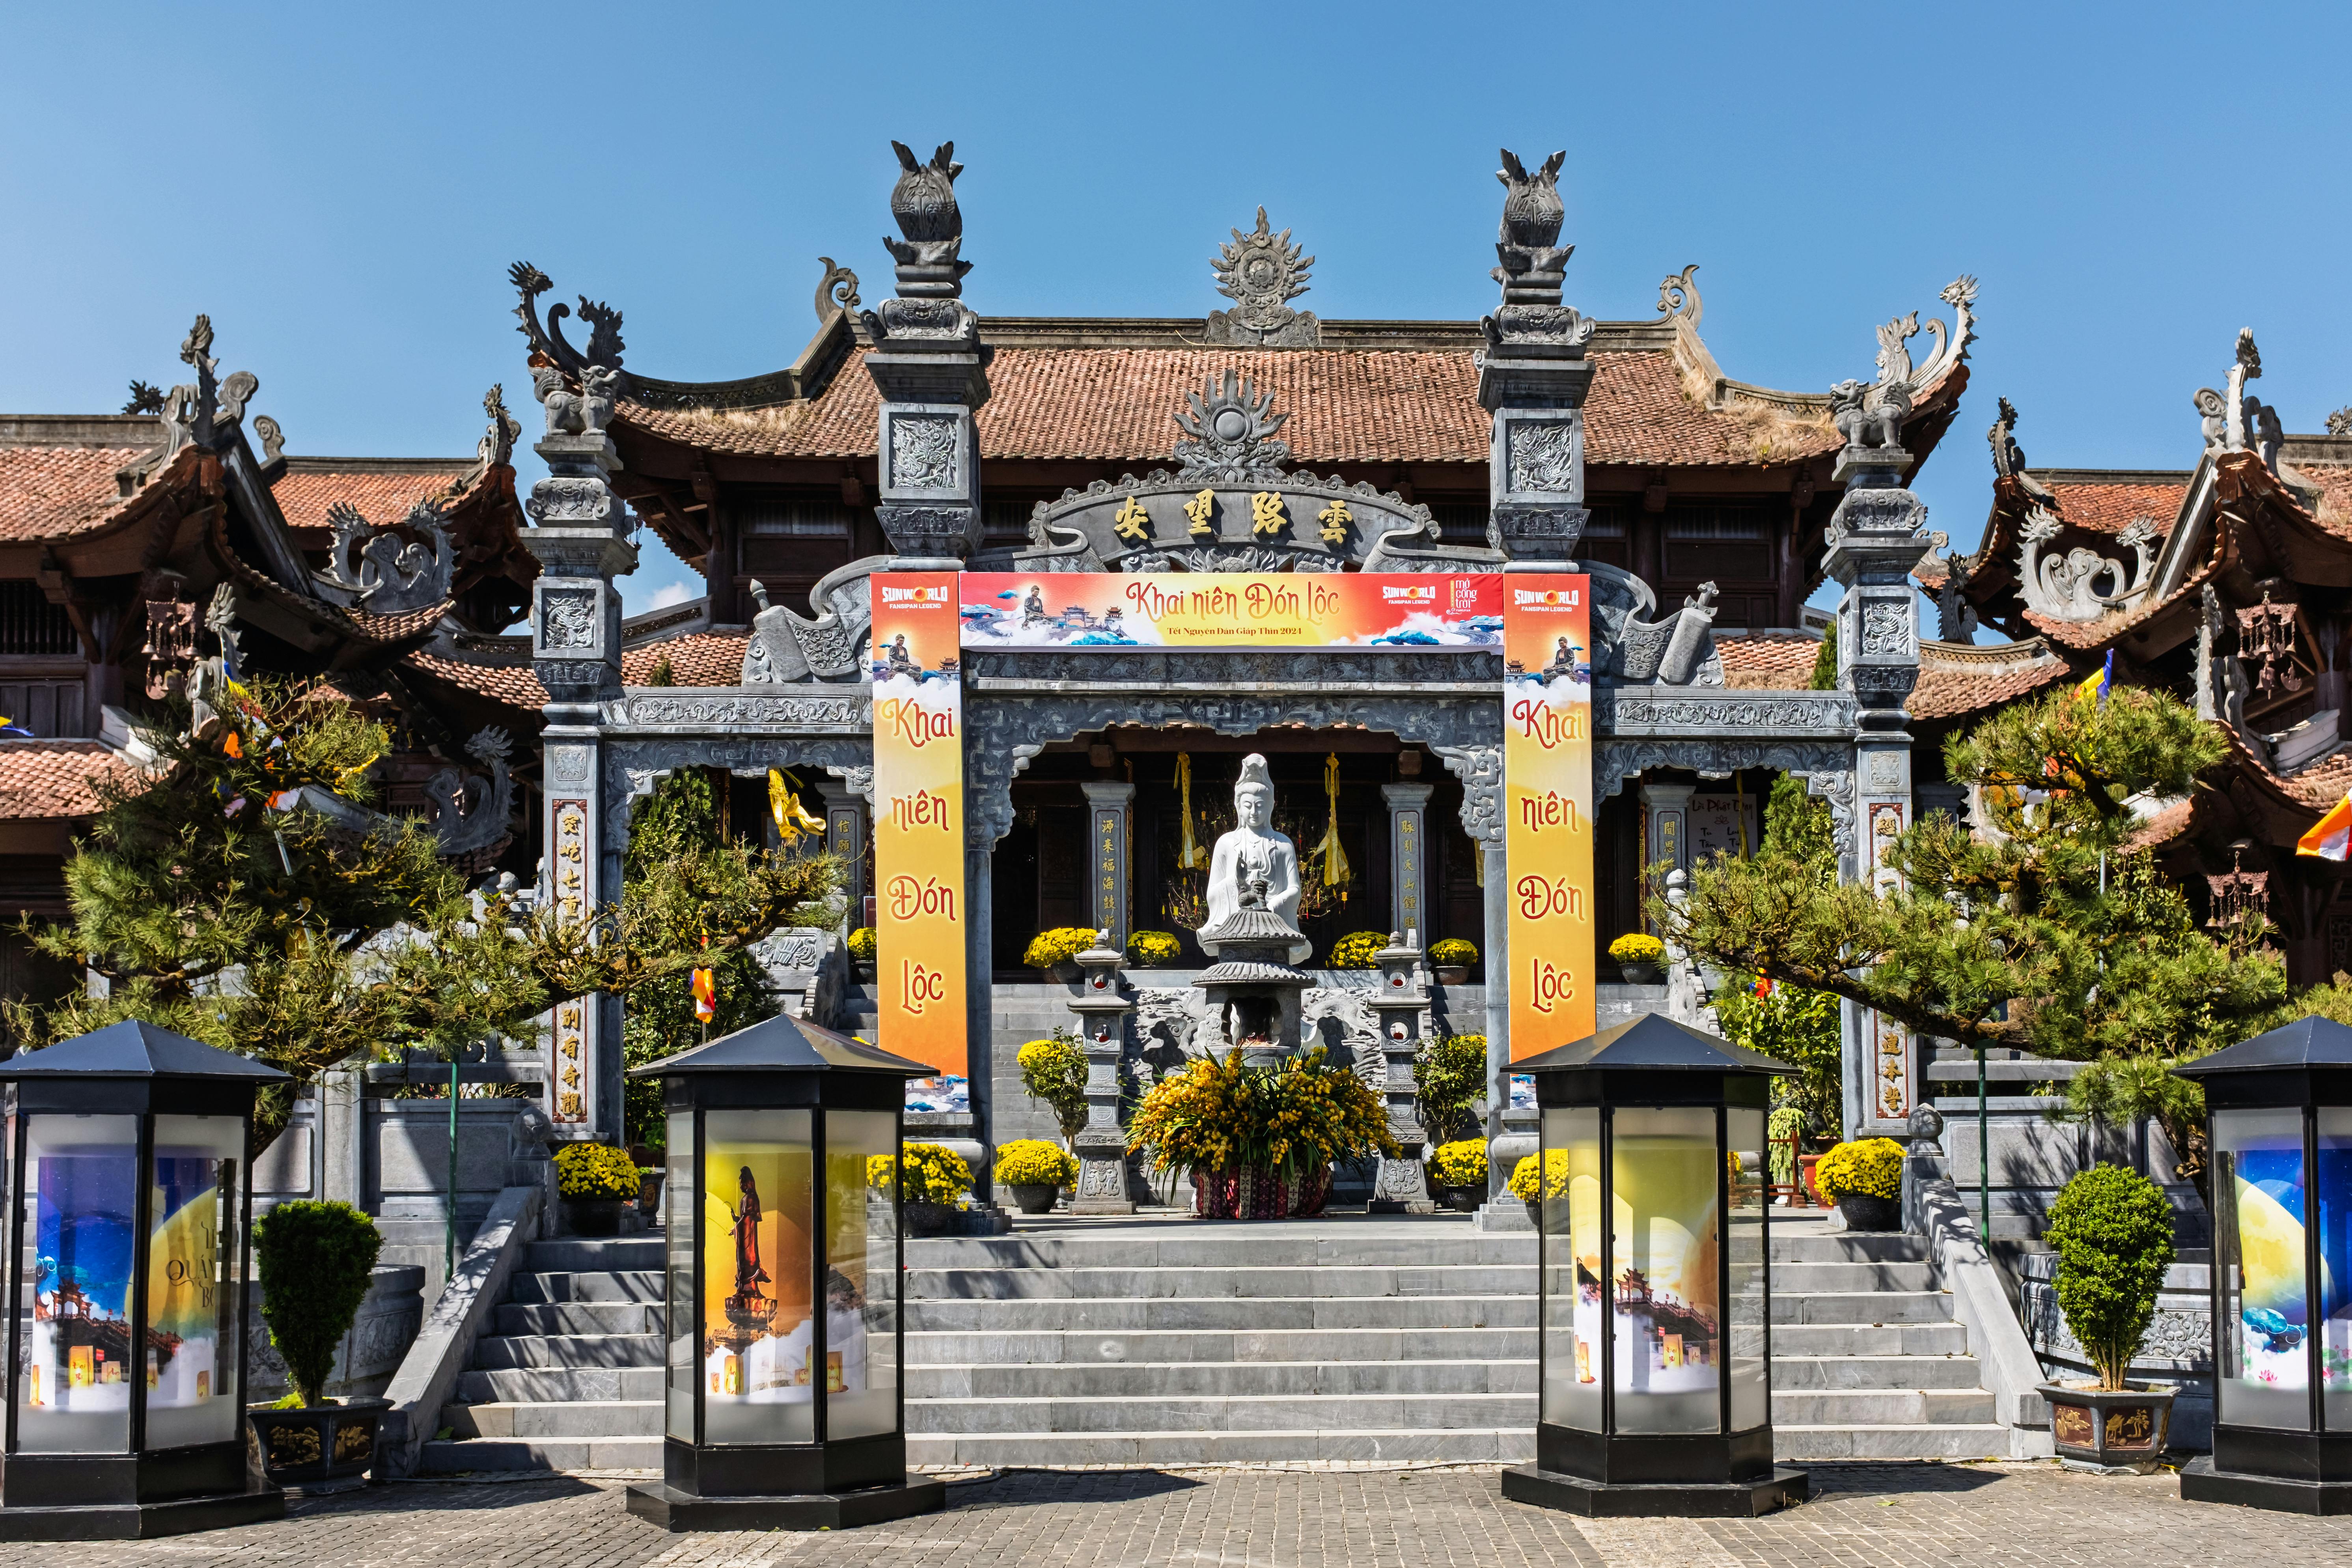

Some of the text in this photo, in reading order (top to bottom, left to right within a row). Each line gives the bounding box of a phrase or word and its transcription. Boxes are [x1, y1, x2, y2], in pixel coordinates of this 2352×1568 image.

[1126, 582, 1186, 623] Khai
[1192, 586, 1238, 620] niên
[1245, 583, 1301, 621] Đón
[1455, 598, 1470, 608] trời
[1456, 578, 1470, 588] mở
[1456, 588, 1477, 602] cổng
[1236, 628, 1256, 636] Giáp
[882, 698, 954, 747] Khai
[1513, 699, 1584, 749] Khai
[891, 789, 949, 831] niên
[1521, 792, 1578, 832] niên
[888, 875, 956, 921] Đón
[1517, 875, 1584, 921] Đón
